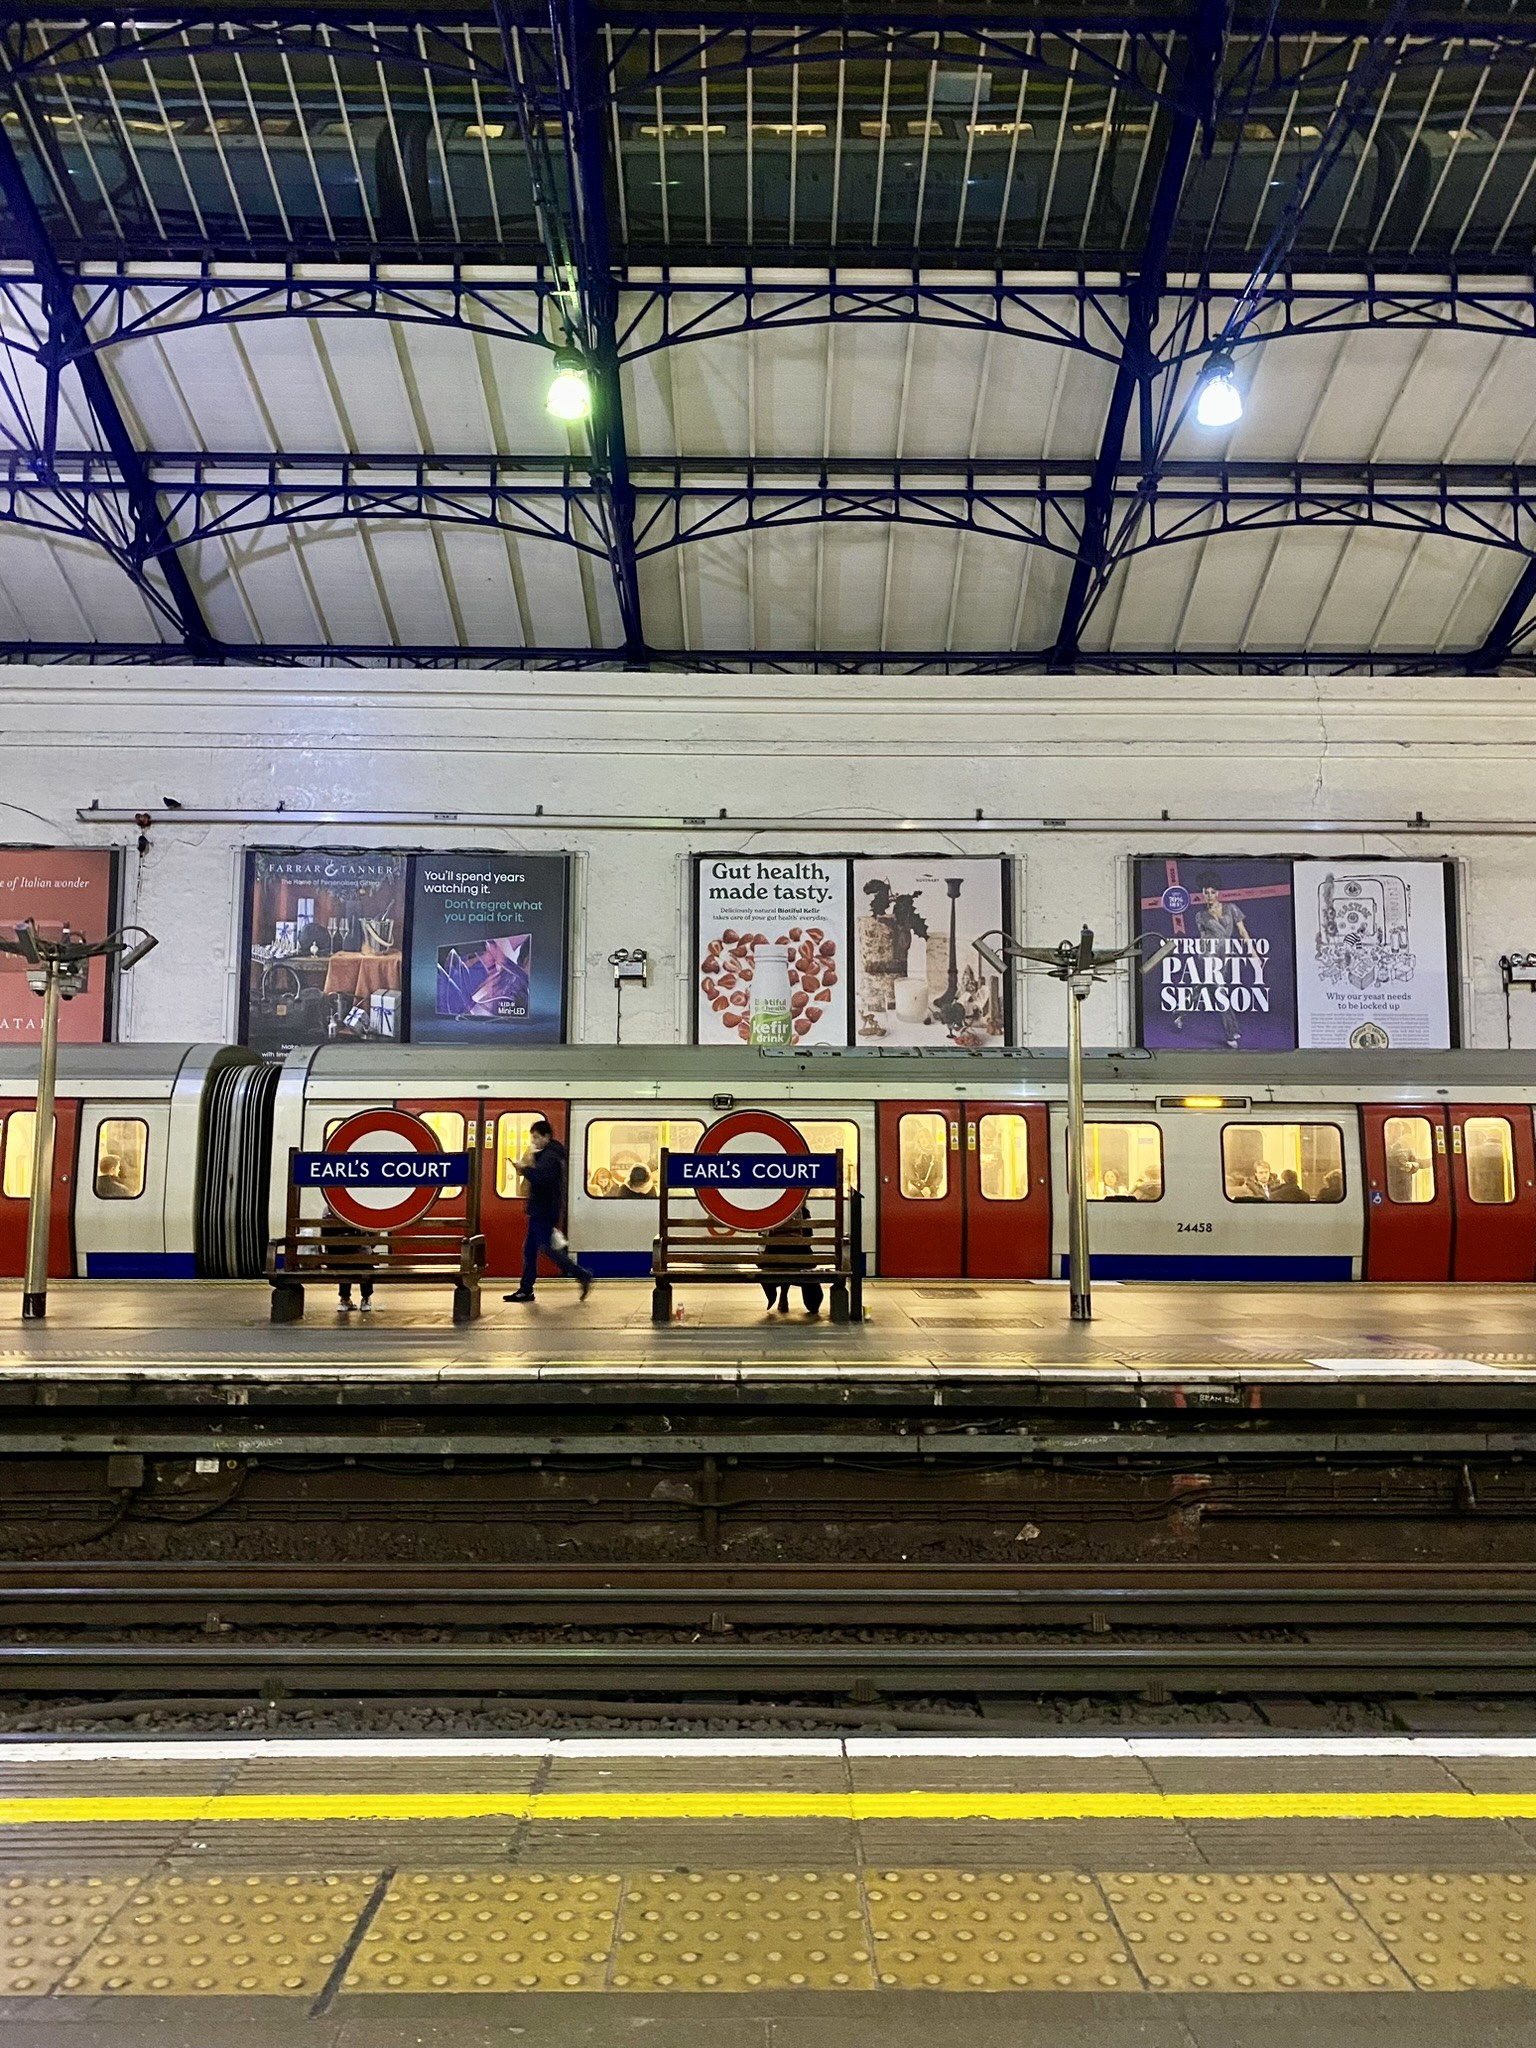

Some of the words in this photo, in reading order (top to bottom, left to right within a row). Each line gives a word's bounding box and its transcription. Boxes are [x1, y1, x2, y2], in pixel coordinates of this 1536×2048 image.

[268, 863, 321, 873] FARRAR
[341, 864, 394, 874] TANNER
[711, 862, 751, 880] Gut
[756, 862, 830, 882] health,
[424, 870, 454, 881] You'll
[455, 871, 491, 884] spend
[493, 873, 525, 884] years
[6, 876, 19, 892] of
[20, 876, 52, 889] Italian
[54, 876, 90, 889] wonder
[423, 883, 479, 896] watching
[481, 884, 491, 894] it.
[709, 882, 768, 900] made
[773, 884, 833, 904] tasty.
[444, 899, 475, 910] Don't
[476, 900, 511, 912] regret
[512, 900, 543, 911] what
[720, 907, 753, 915] Deliciously
[444, 913, 466, 924] you
[468, 912, 494, 924] paid
[497, 912, 513, 922] for
[514, 912, 525, 923] it.
[1223, 938, 1270, 955] INTO
[1161, 956, 1269, 985] PARTY
[755, 998, 787, 1006] Btiful
[1160, 986, 1270, 1012] SEASON
[1326, 993, 1345, 1001] Why
[1363, 993, 1385, 1001] yeast
[1387, 992, 1412, 1000] needs
[1348, 1002, 1359, 1010] be
[1360, 1002, 1388, 1010] locked
[1389, 1003, 1400, 1011] up
[0, 1018, 61, 1030] ATA
[752, 1020, 789, 1034] kefir
[756, 1034, 784, 1043] drink
[310, 1159, 370, 1178] EARL'S
[381, 1162, 452, 1178] COURT
[683, 1160, 741, 1178] EARL'S
[752, 1163, 821, 1179] COURT
[1177, 1222, 1212, 1232] 24458
